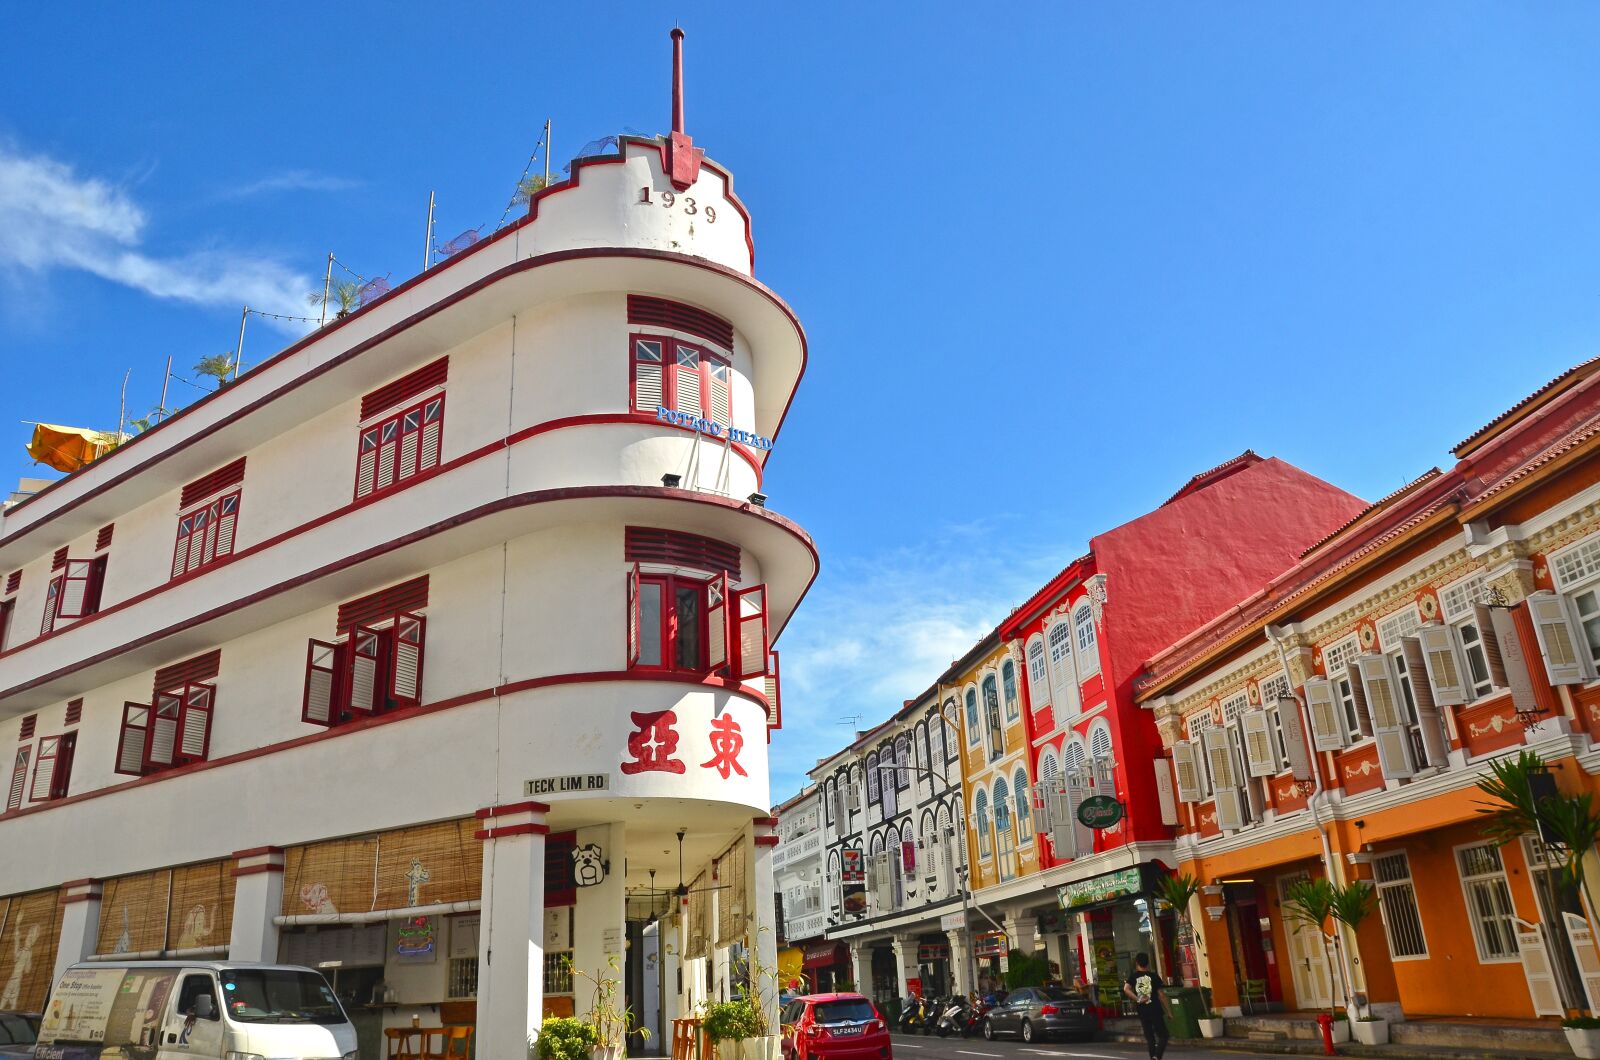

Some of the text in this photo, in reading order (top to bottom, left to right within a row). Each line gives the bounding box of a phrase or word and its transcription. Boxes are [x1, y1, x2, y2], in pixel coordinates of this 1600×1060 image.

[639, 186, 716, 224] 1939
[656, 405, 773, 451] POTATO HEAD
[528, 775, 604, 794] TECK LIM RD
